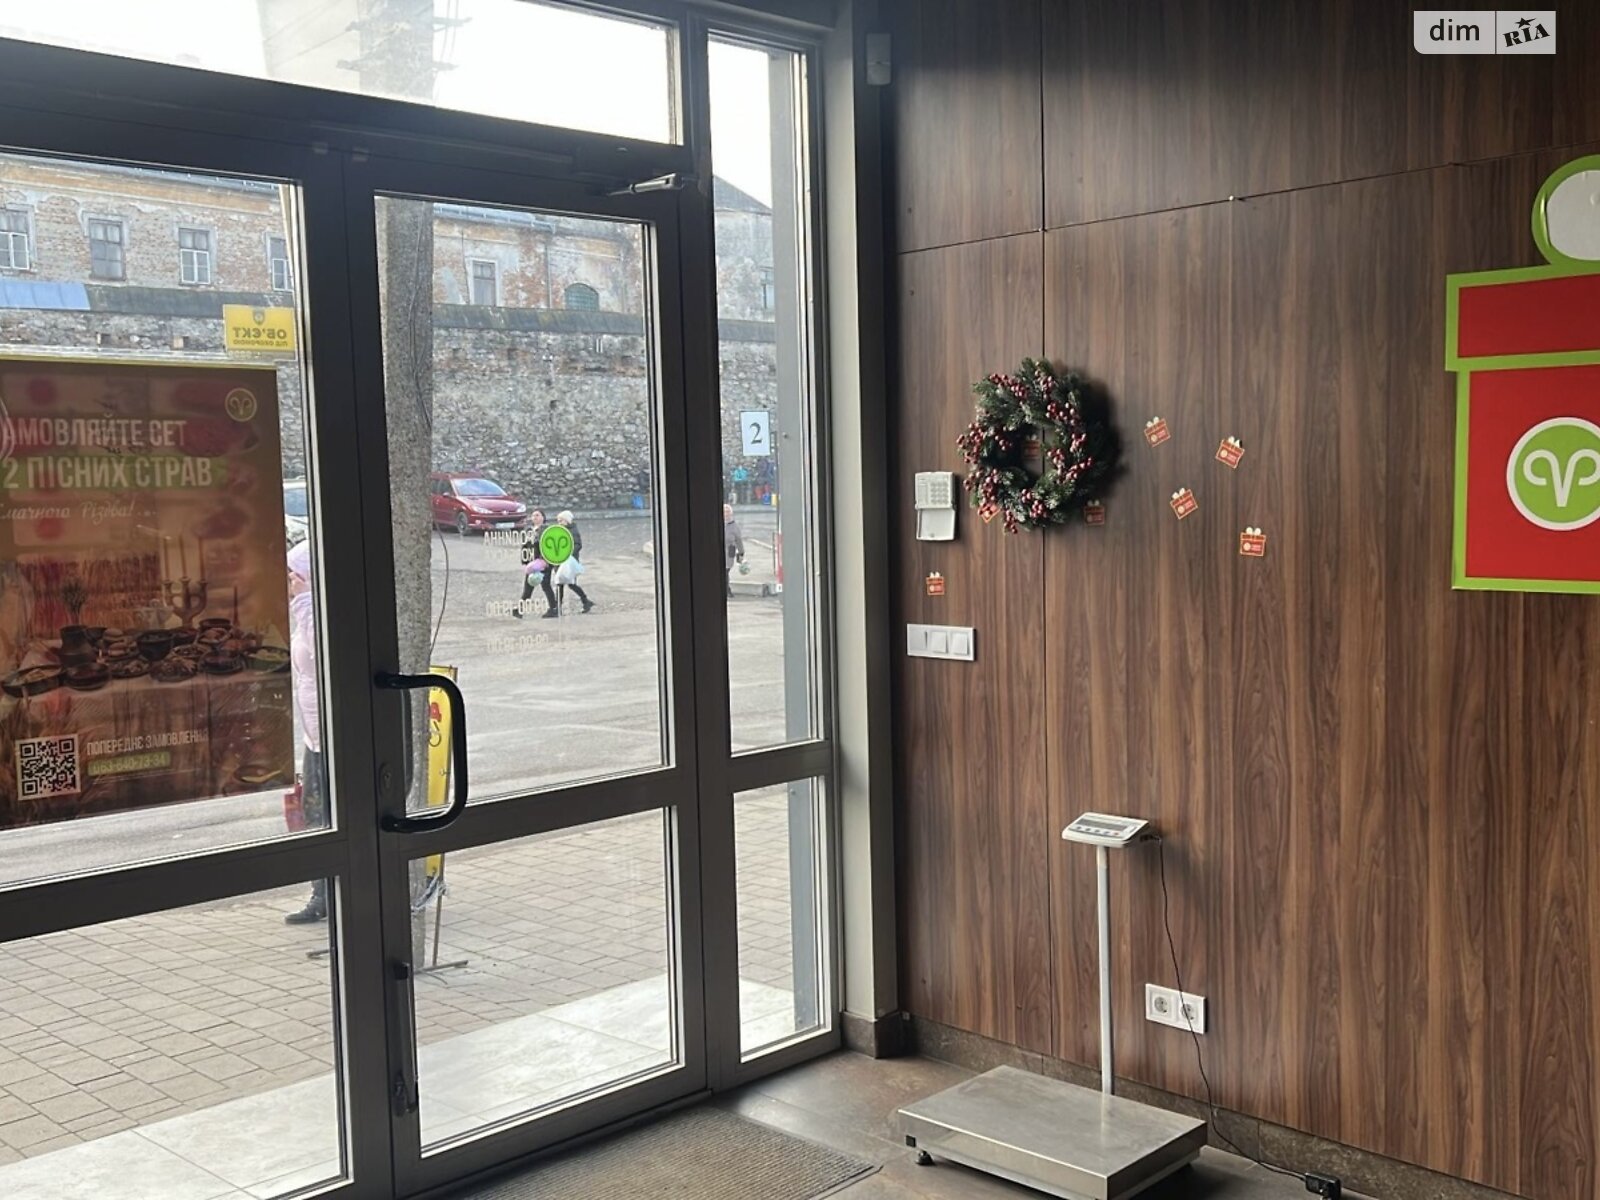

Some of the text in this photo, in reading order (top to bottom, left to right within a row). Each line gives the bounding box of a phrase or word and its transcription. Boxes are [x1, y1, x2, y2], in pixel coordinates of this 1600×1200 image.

[149, 419, 187, 446] СЕТ
[750, 422, 763, 444] 2
[27, 456, 129, 489] ПІСНИХ
[135, 456, 212, 487] СТРАВ
[87, 736, 143, 755] ПОПЕРЕДНЄ
